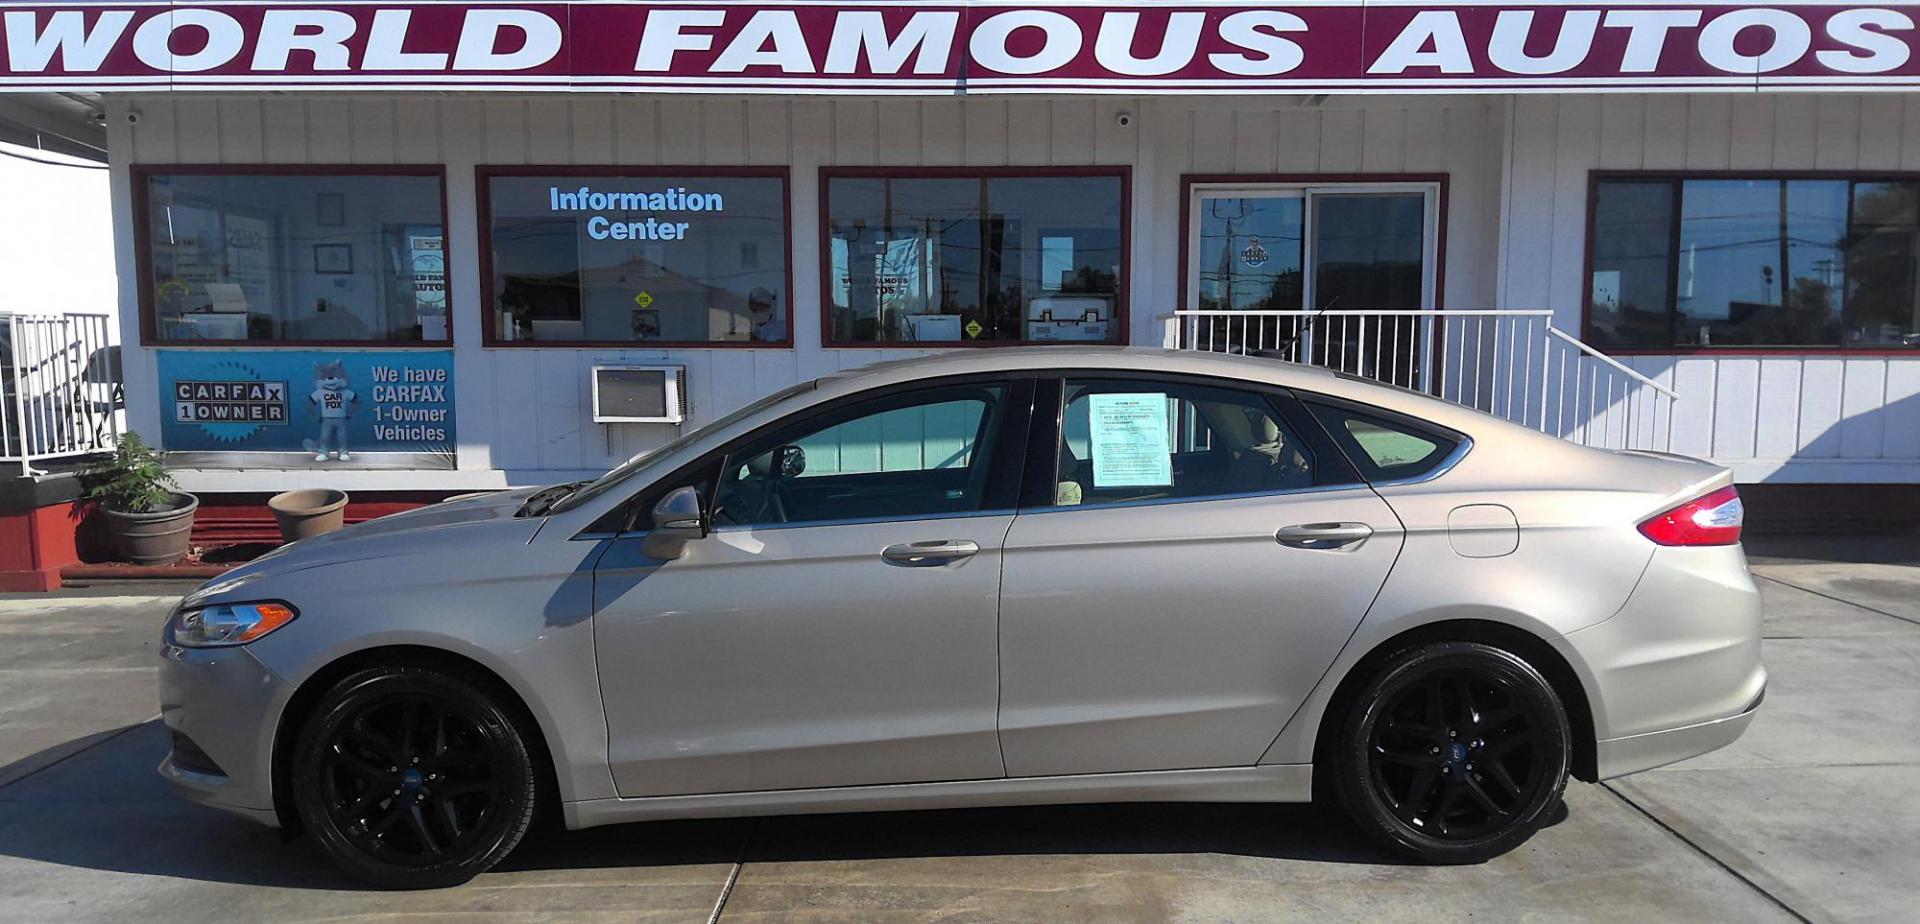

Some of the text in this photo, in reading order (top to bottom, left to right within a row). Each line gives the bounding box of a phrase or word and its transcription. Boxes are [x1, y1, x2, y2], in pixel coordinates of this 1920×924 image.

[3, 8, 1916, 75] WORLD FAMOUS AUTOS
[550, 186, 723, 211] Information
[587, 216, 689, 240] Center
[372, 366, 446, 382] We have
[178, 384, 280, 400] CARFAX
[323, 393, 342, 401] CAR
[372, 386, 446, 402] CARFAX
[181, 405, 281, 418] 1 OWNER
[373, 406, 447, 421] 1-Owner
[373, 425, 445, 440] Vehicles
